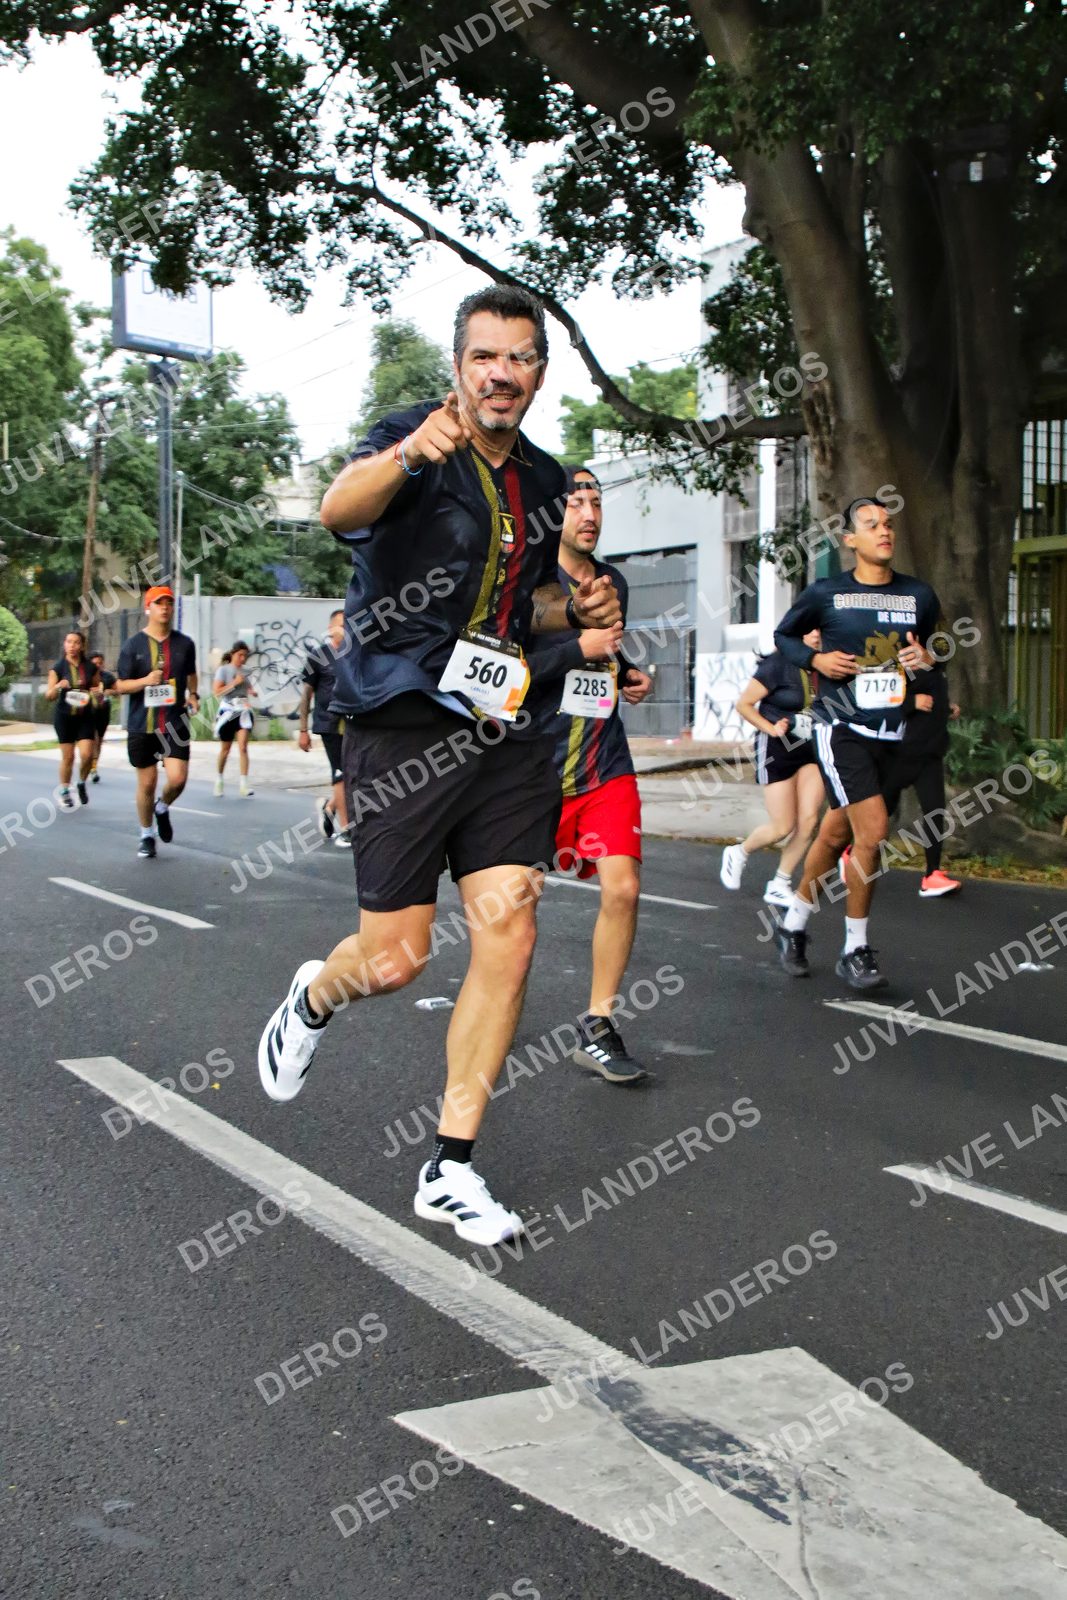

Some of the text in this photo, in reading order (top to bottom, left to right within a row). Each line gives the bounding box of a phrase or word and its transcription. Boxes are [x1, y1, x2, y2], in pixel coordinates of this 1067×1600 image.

[833, 593, 916, 612] CORREDORES
[877, 611, 890, 622] DE
[463, 655, 508, 688] 560
[572, 677, 607, 697] 2285
[864, 679, 897, 693] 7170
